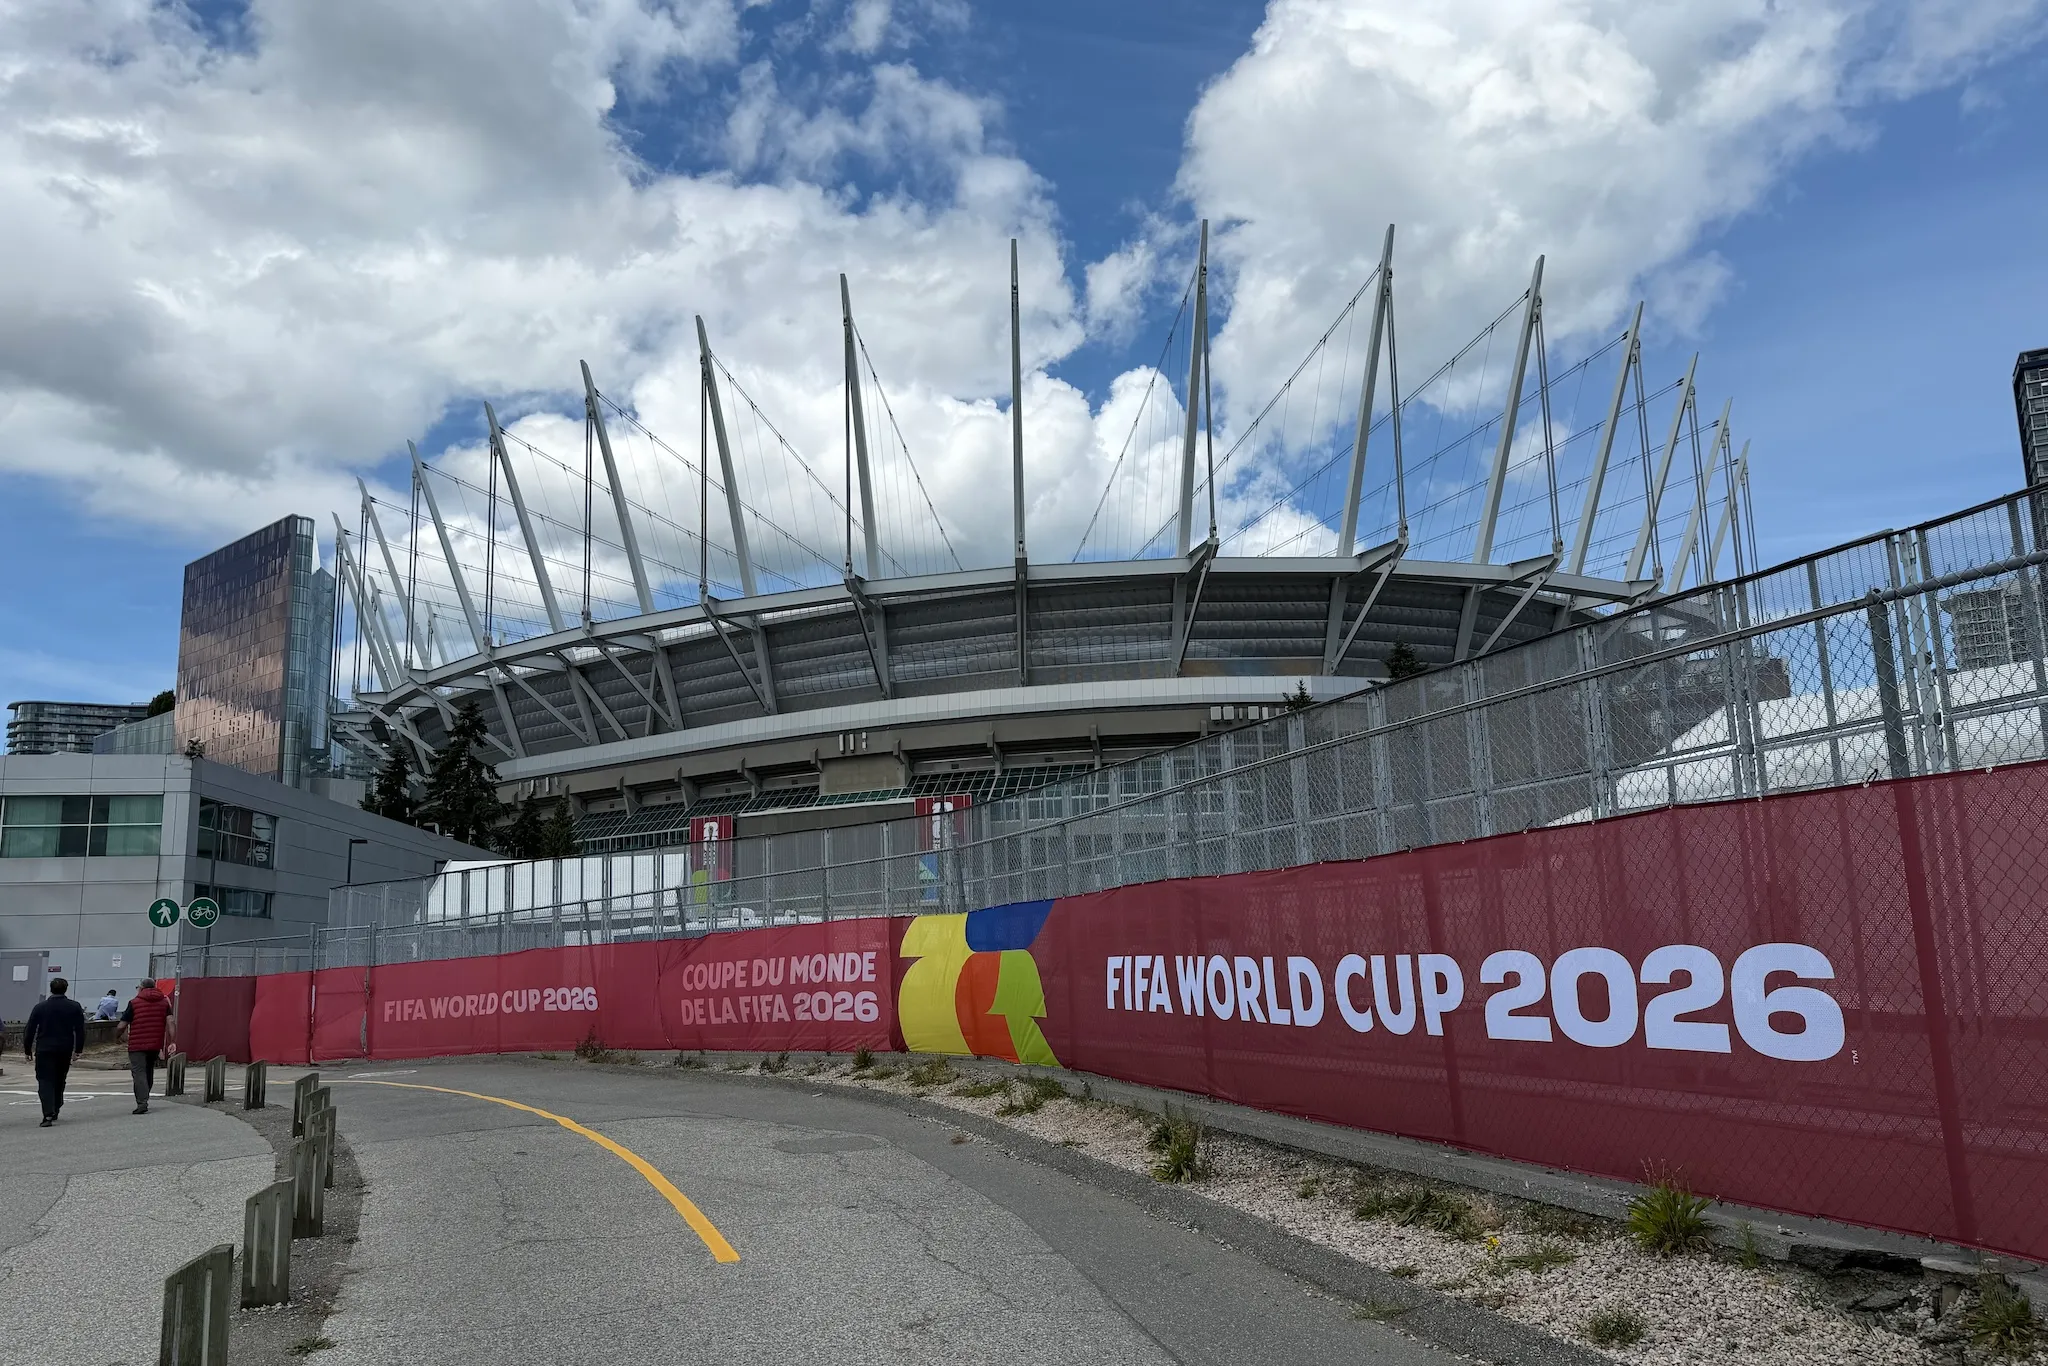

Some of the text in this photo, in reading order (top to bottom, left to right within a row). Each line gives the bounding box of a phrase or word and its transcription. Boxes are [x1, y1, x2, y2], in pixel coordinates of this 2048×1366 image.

[682, 951, 877, 991] COUPE DU MONDE
[384, 986, 599, 1022] FIFA WORLD CUP 2026
[681, 991, 879, 1026] DE LA FIFA 2026
[1106, 955, 1173, 1014] FIFA
[1174, 954, 1325, 1027] WORLD
[1334, 953, 1464, 1036] CUP
[1480, 942, 1846, 1062] 2026
